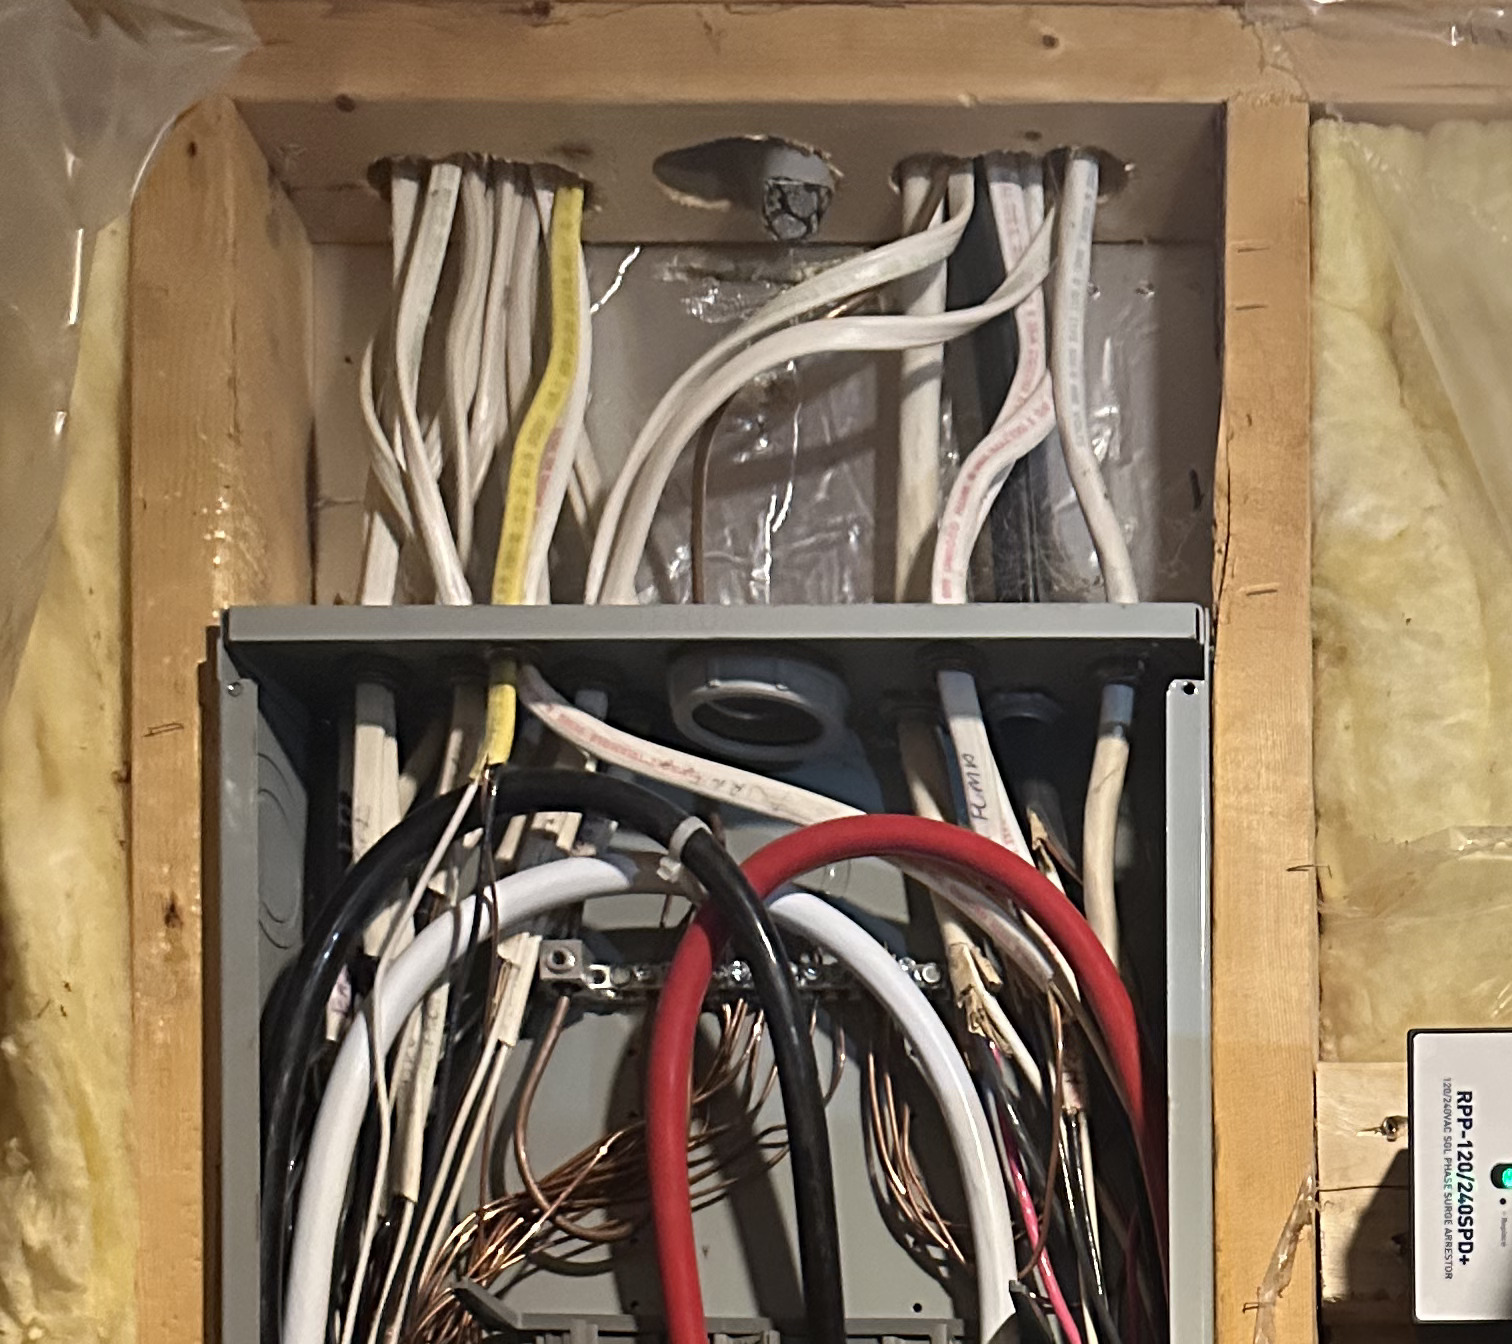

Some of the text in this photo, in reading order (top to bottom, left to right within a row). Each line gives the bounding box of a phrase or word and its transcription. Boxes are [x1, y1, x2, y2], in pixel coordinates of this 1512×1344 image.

[1444, 1157, 1452, 1190] PHASE
[1456, 1090, 1475, 1266] RPP-120/240SPD+
[1444, 1192, 1452, 1225] SURGE
